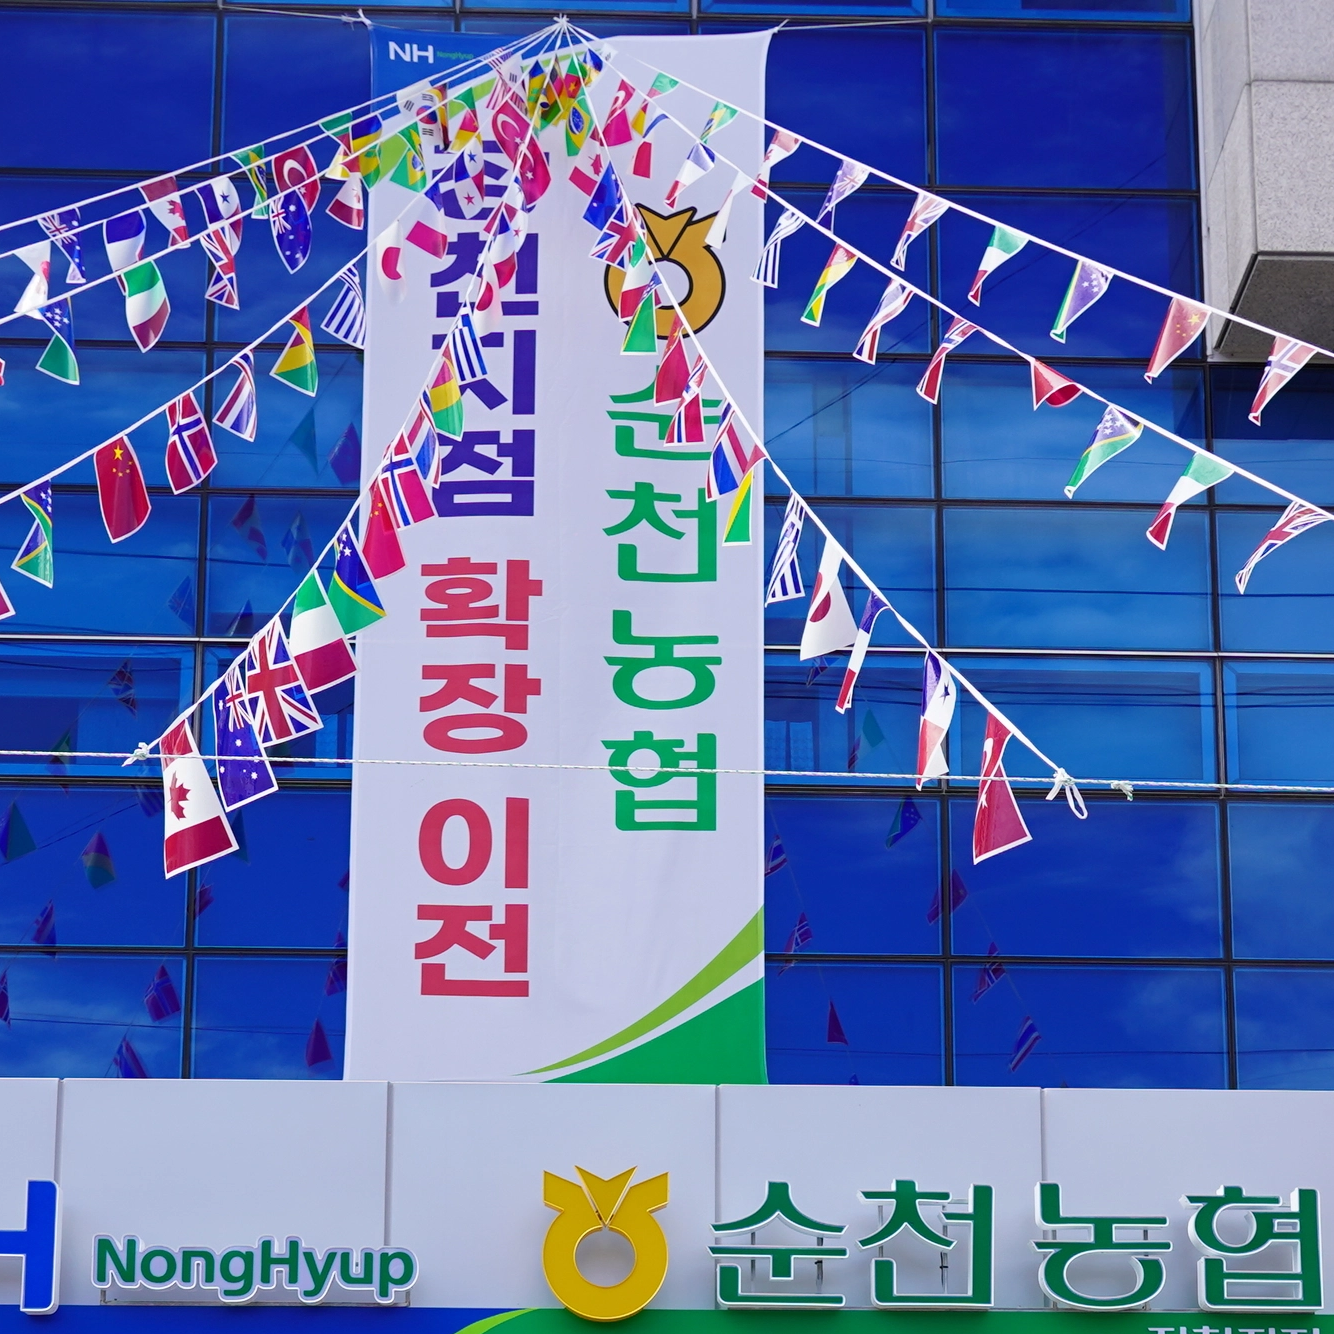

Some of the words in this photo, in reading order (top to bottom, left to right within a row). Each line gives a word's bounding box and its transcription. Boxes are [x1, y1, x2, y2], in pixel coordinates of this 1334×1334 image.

[388, 41, 434, 63] NH
[419, 557, 543, 755] 확장
[601, 365, 723, 832] 순천농협
[414, 797, 530, 998] 이전
[91, 1234, 419, 1304] NongHyup
[707, 1179, 1326, 1314] 순천농협
